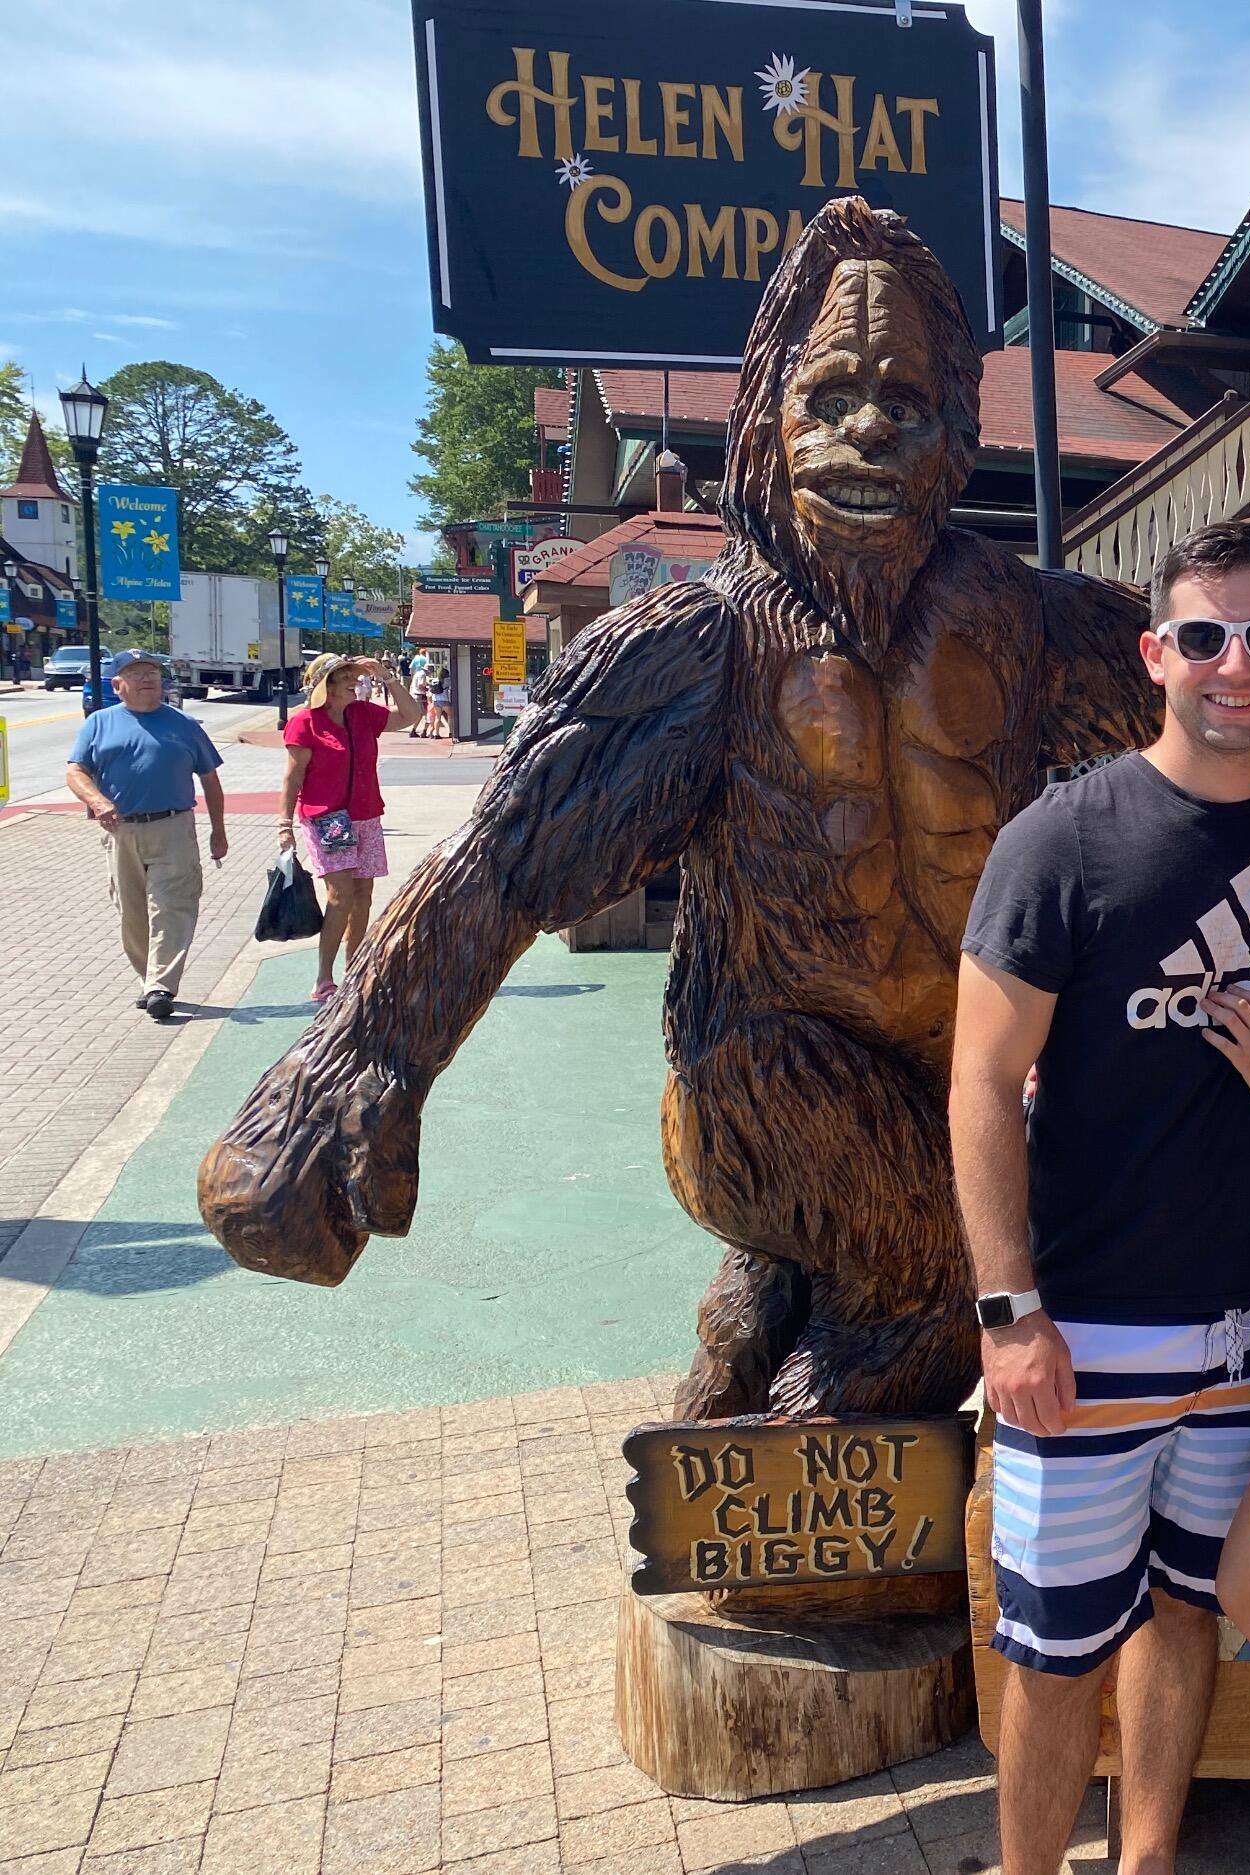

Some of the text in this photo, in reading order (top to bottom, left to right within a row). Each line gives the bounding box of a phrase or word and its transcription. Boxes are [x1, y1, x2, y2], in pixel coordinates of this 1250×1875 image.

[486, 47, 940, 189] HELEN HAT
[108, 495, 168, 512] Welcome
[111, 576, 143, 589] Alpine
[144, 577, 171, 588] Helen
[670, 1434, 920, 1502] DO NOT
[712, 1487, 897, 1541] CLIMB
[690, 1514, 934, 1583] BIGGY!
